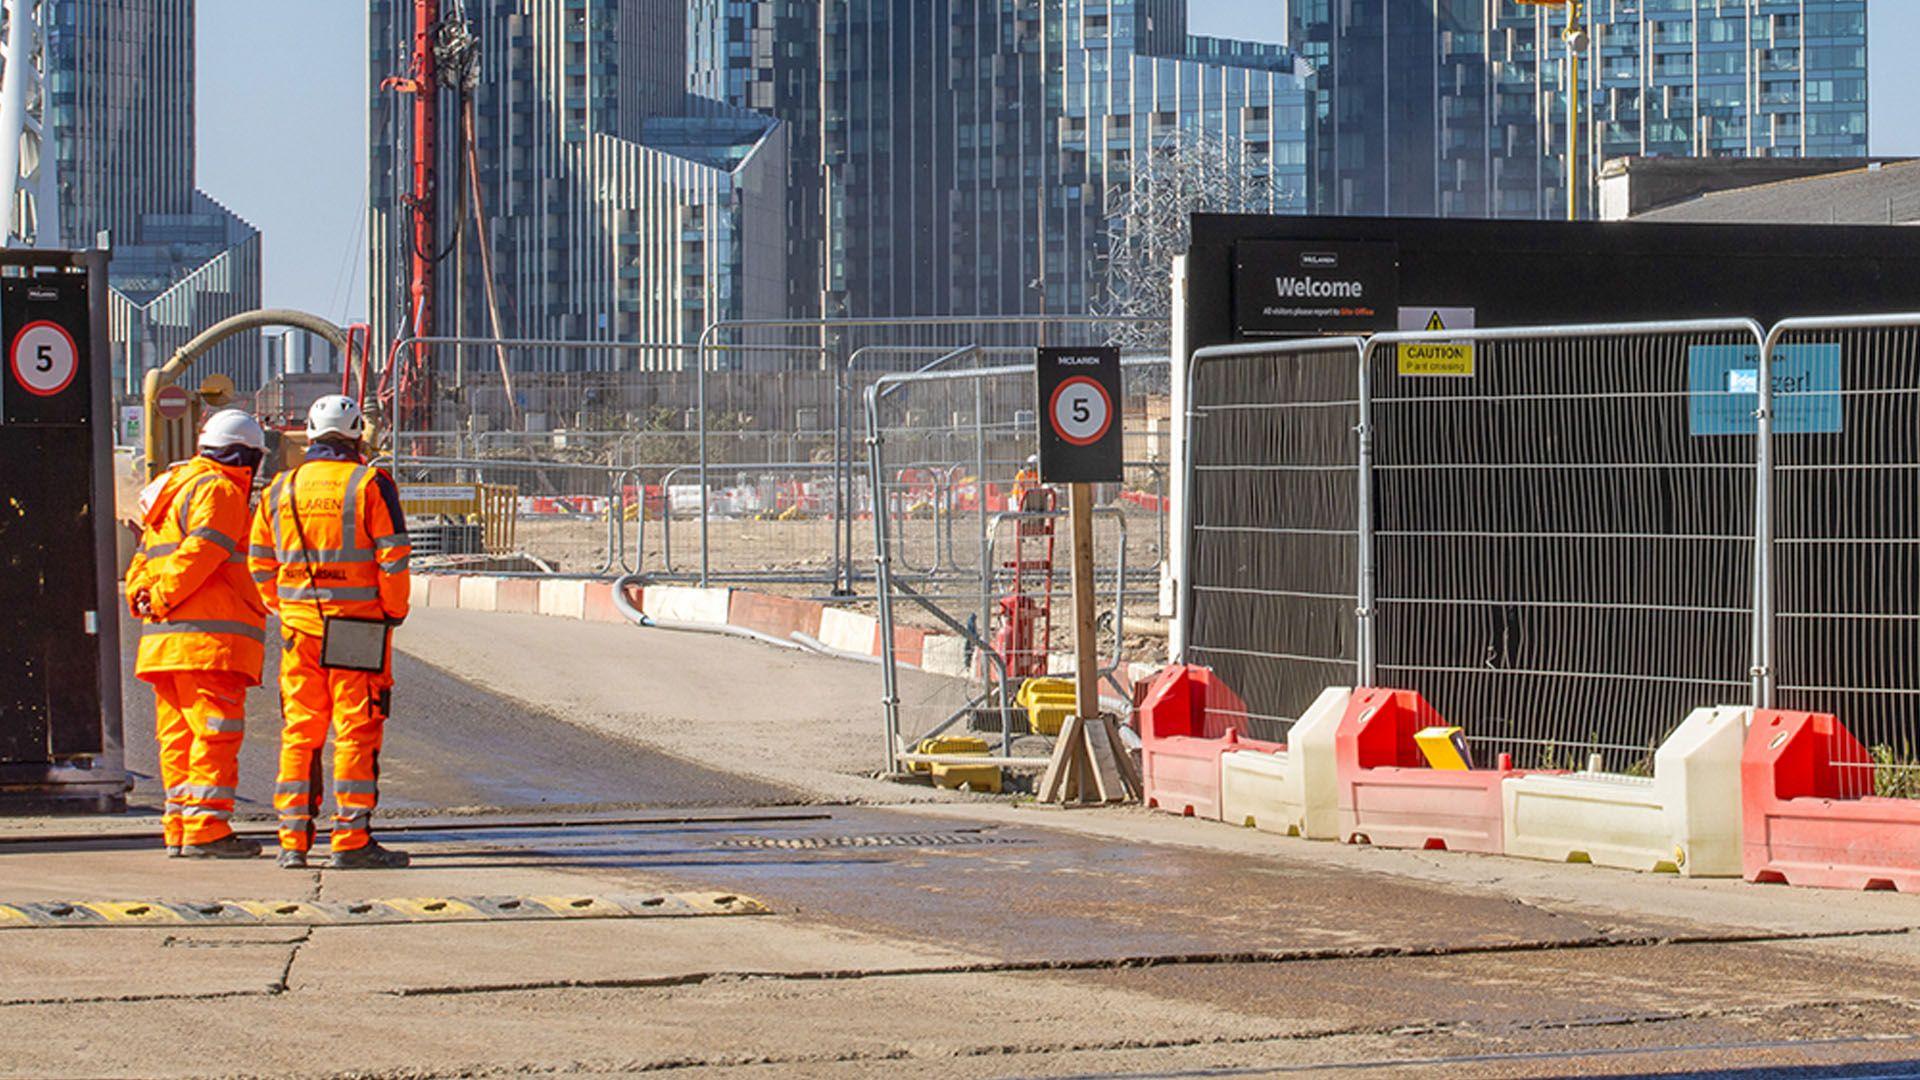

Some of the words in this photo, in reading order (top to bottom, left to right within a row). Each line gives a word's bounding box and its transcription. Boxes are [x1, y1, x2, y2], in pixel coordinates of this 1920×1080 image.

[1275, 276, 1363, 297] Welcome
[36, 345, 53, 372] 5
[1406, 346, 1464, 359] CAUTION
[1072, 398, 1090, 423] 5
[280, 498, 342, 511] MLAREN
